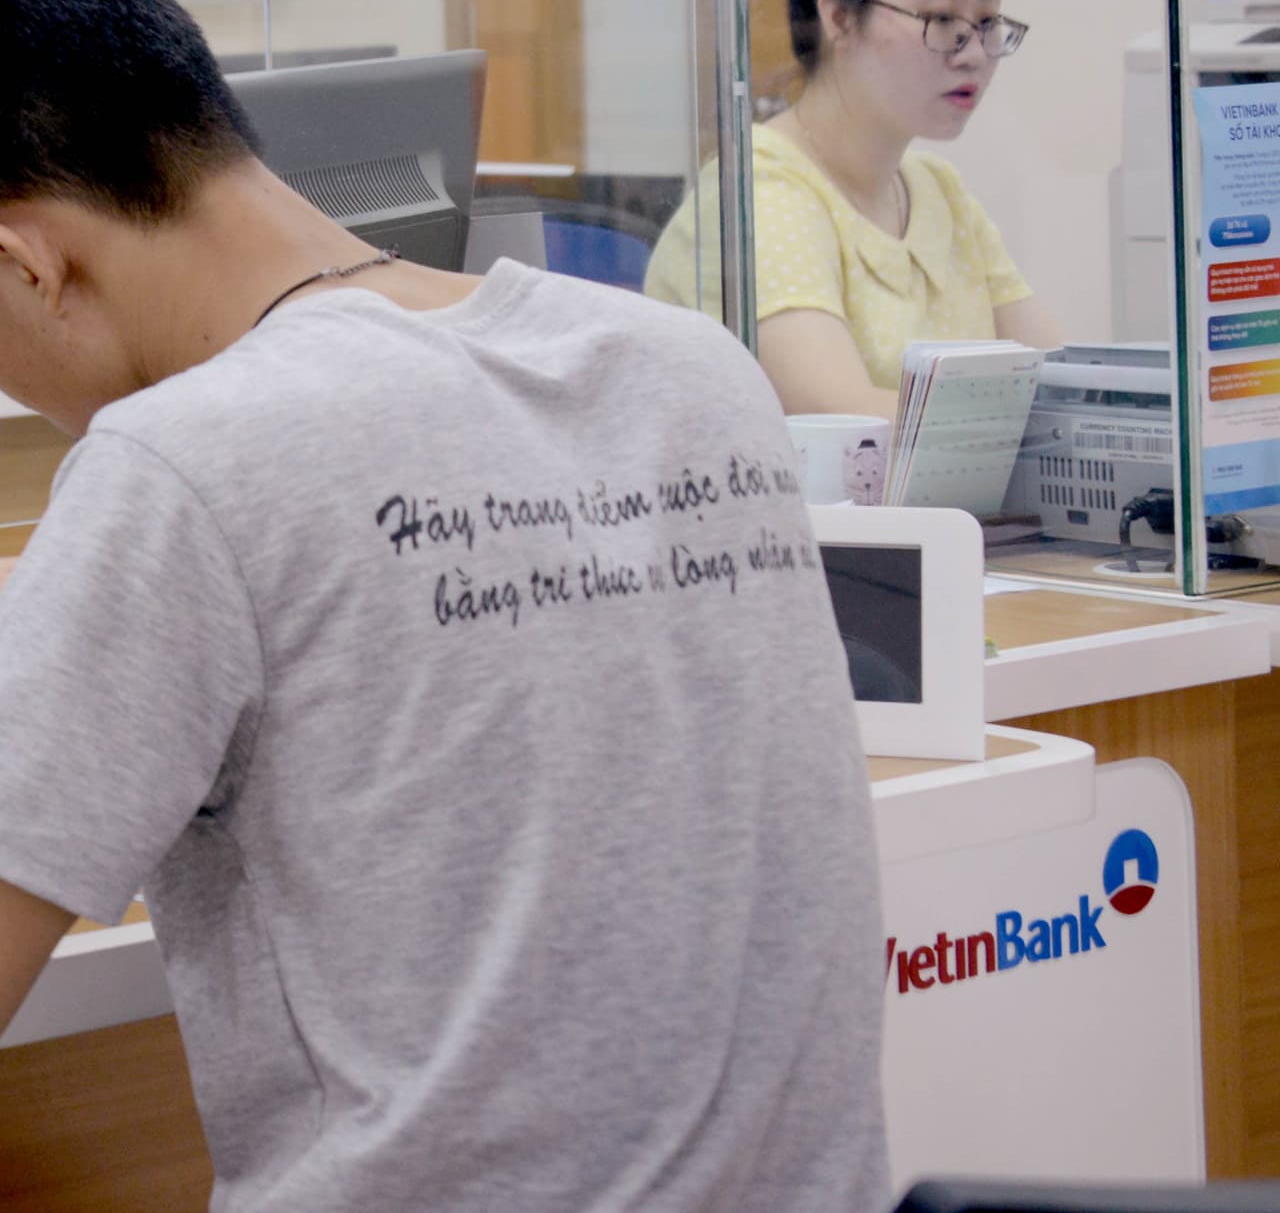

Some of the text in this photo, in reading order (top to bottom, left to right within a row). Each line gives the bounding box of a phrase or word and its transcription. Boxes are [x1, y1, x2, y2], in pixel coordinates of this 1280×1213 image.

[376, 494, 475, 557] Hãy
[484, 492, 572, 539] trang
[577, 480, 652, 528] điểm
[433, 567, 523, 626] bằng
[670, 543, 737, 594] lòng
